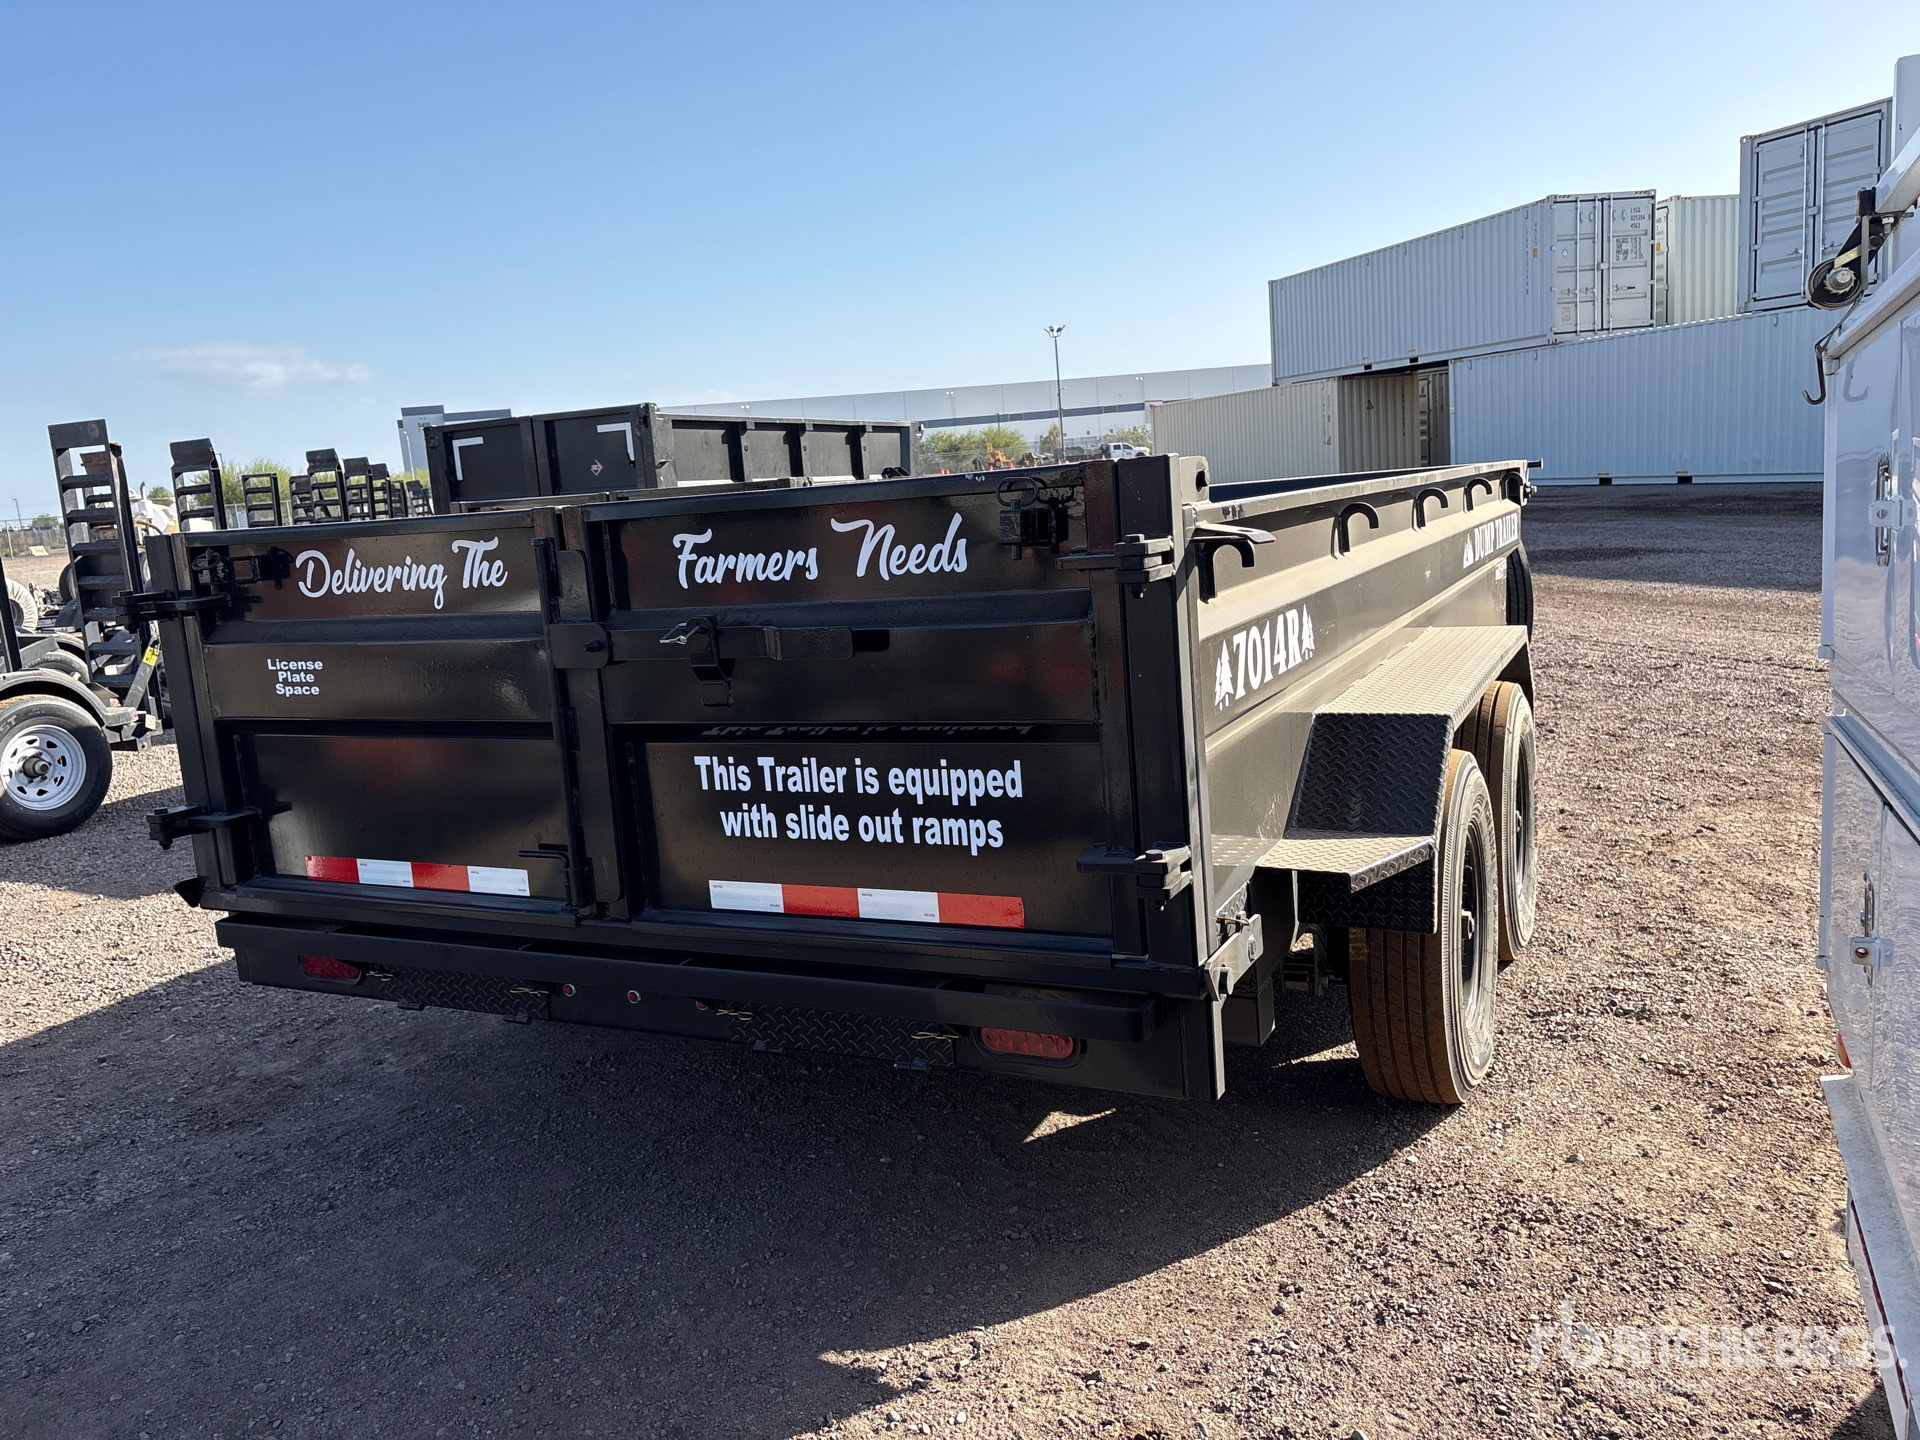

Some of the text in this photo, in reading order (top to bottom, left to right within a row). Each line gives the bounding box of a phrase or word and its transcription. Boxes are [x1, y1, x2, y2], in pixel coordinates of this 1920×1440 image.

[672, 512, 968, 590] Farmers Needs
[1474, 521, 1495, 562] DUMP
[295, 536, 509, 610] Delivering The
[266, 658, 324, 670] License
[277, 670, 314, 683] Plate
[1232, 608, 1303, 701] 7014R
[275, 683, 320, 698] Space
[693, 755, 1024, 807] This Trailer is equipped
[719, 803, 1005, 857] with slide out ramps
